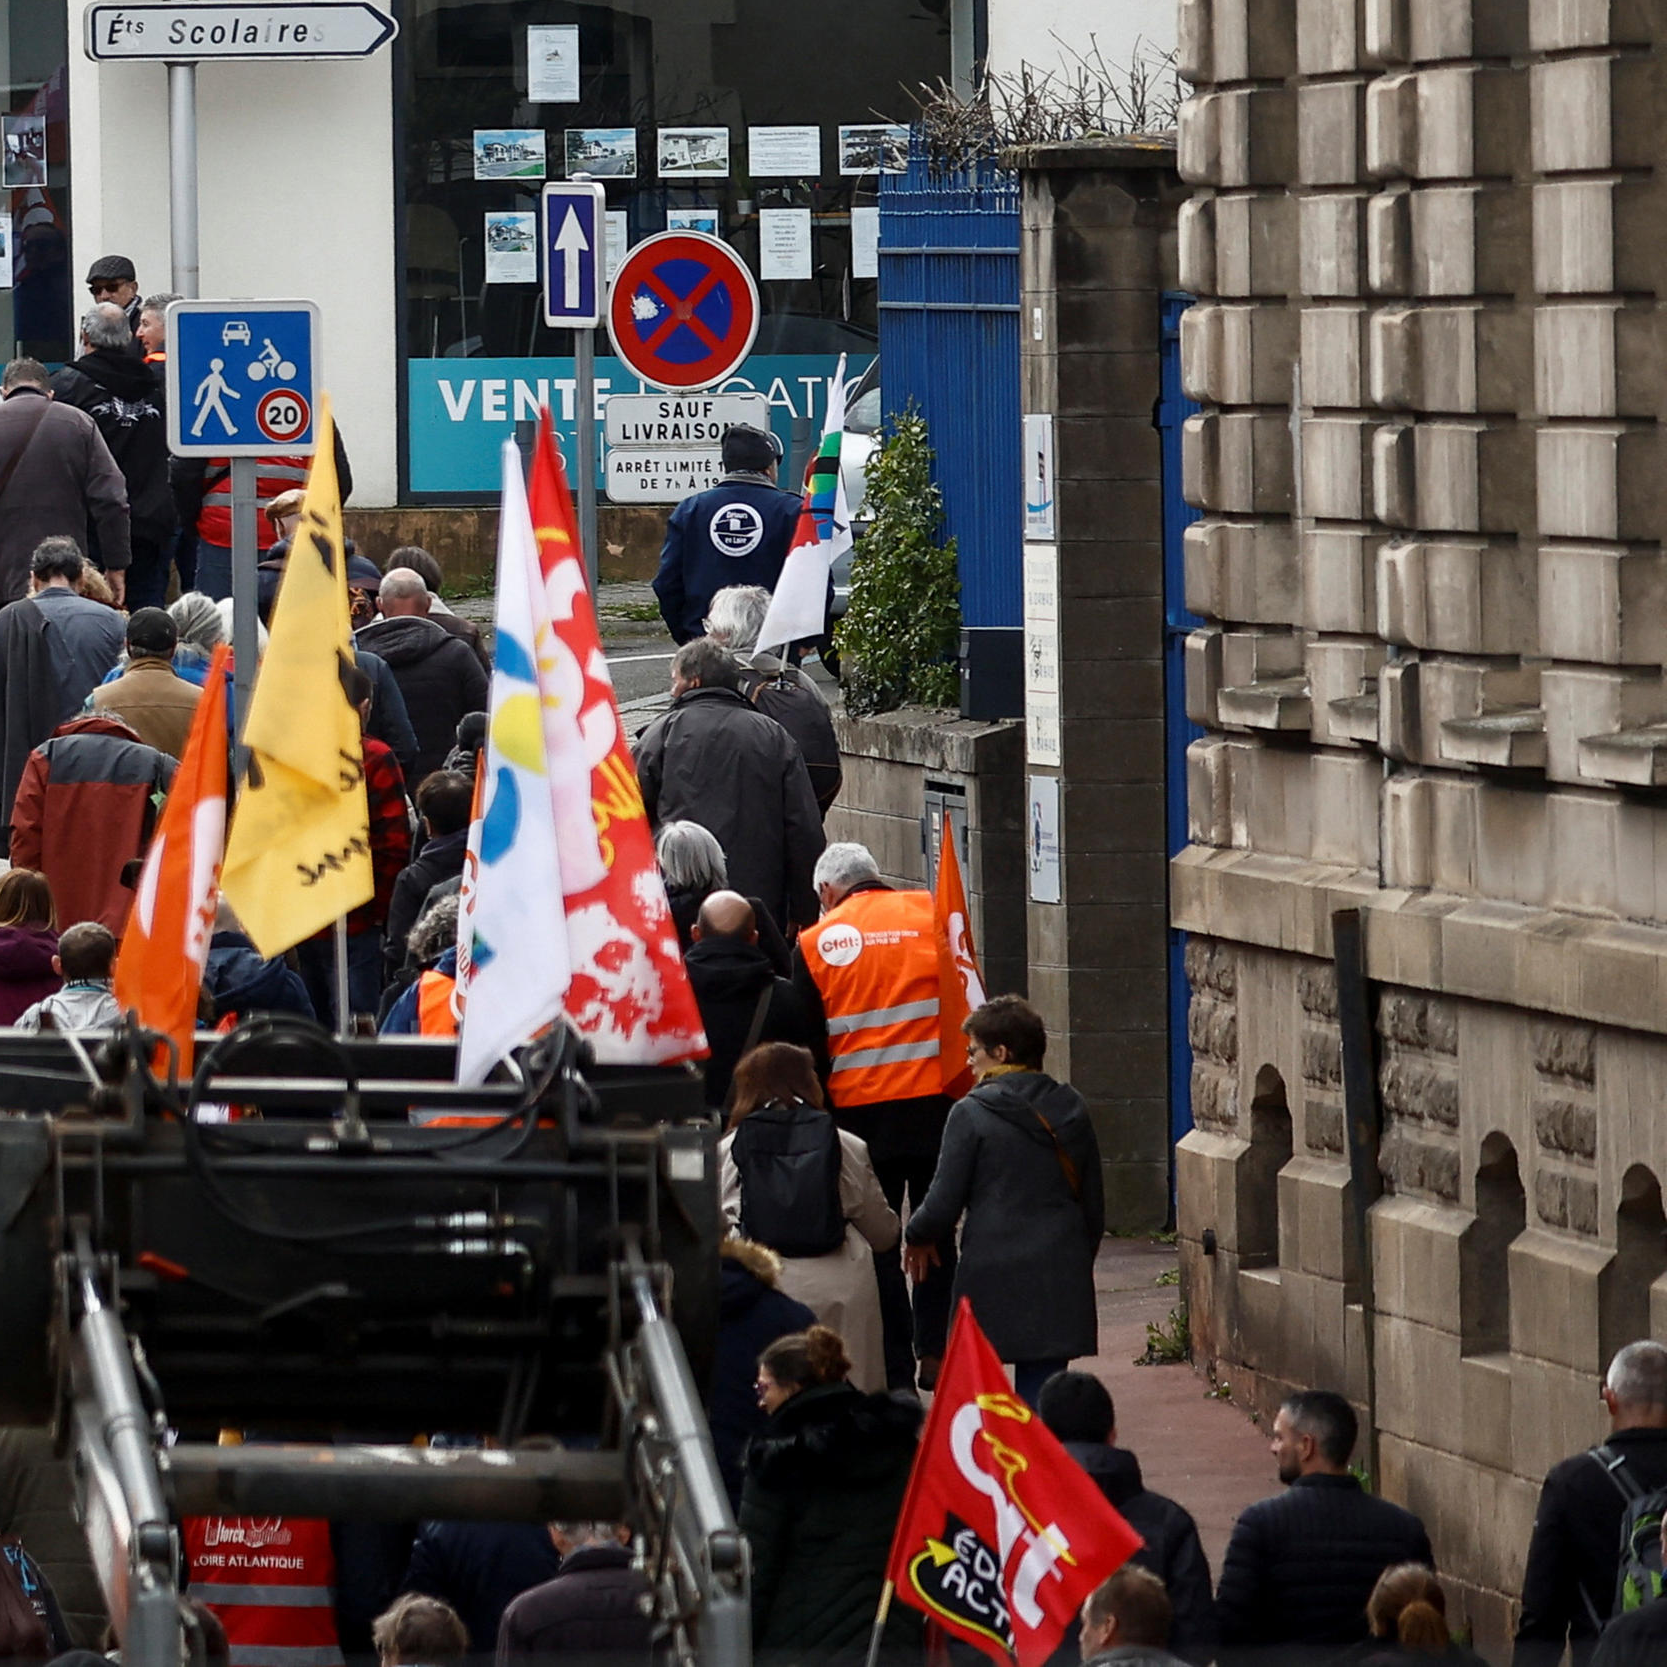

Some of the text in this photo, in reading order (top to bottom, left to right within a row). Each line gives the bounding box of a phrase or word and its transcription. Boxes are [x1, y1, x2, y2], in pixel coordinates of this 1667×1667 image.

[107, 13, 326, 46] Éts Scolaires
[436, 378, 612, 422] VENTE
[268, 405, 298, 425] 20
[659, 401, 714, 419] SAUF
[615, 458, 712, 474] ARRÊT LIMITÉ
[640, 474, 698, 490] DE 7h À
[821, 934, 862, 953] Cfdt:
[193, 1555, 305, 1571] LOIRE ATLANTIQUE
